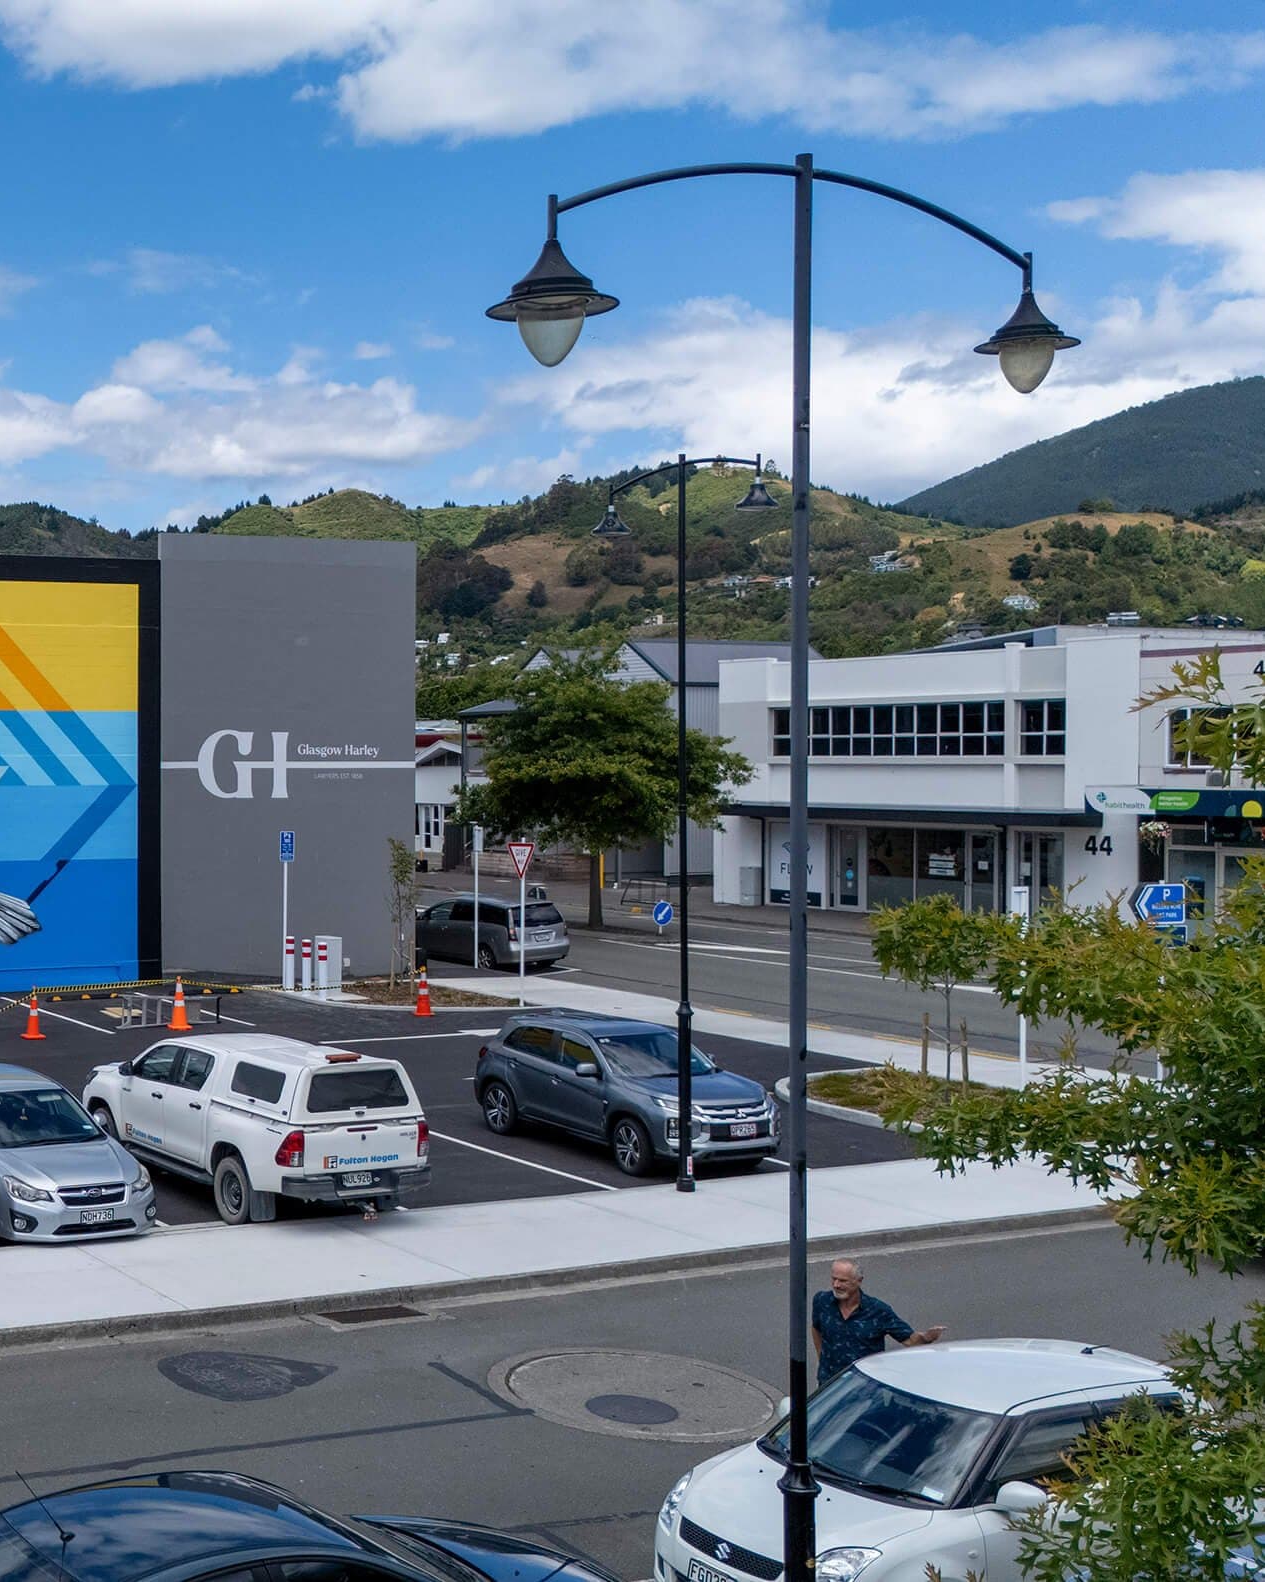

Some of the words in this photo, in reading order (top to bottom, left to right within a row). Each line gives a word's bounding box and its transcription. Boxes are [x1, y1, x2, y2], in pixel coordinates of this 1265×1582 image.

[297, 743, 342, 758] Glasgow
[344, 744, 379, 759] Harley
[1084, 835, 1113, 856] 44
[1163, 888, 1171, 901] P
[339, 1156, 368, 1165] Fulton
[370, 1153, 399, 1163] Hogan
